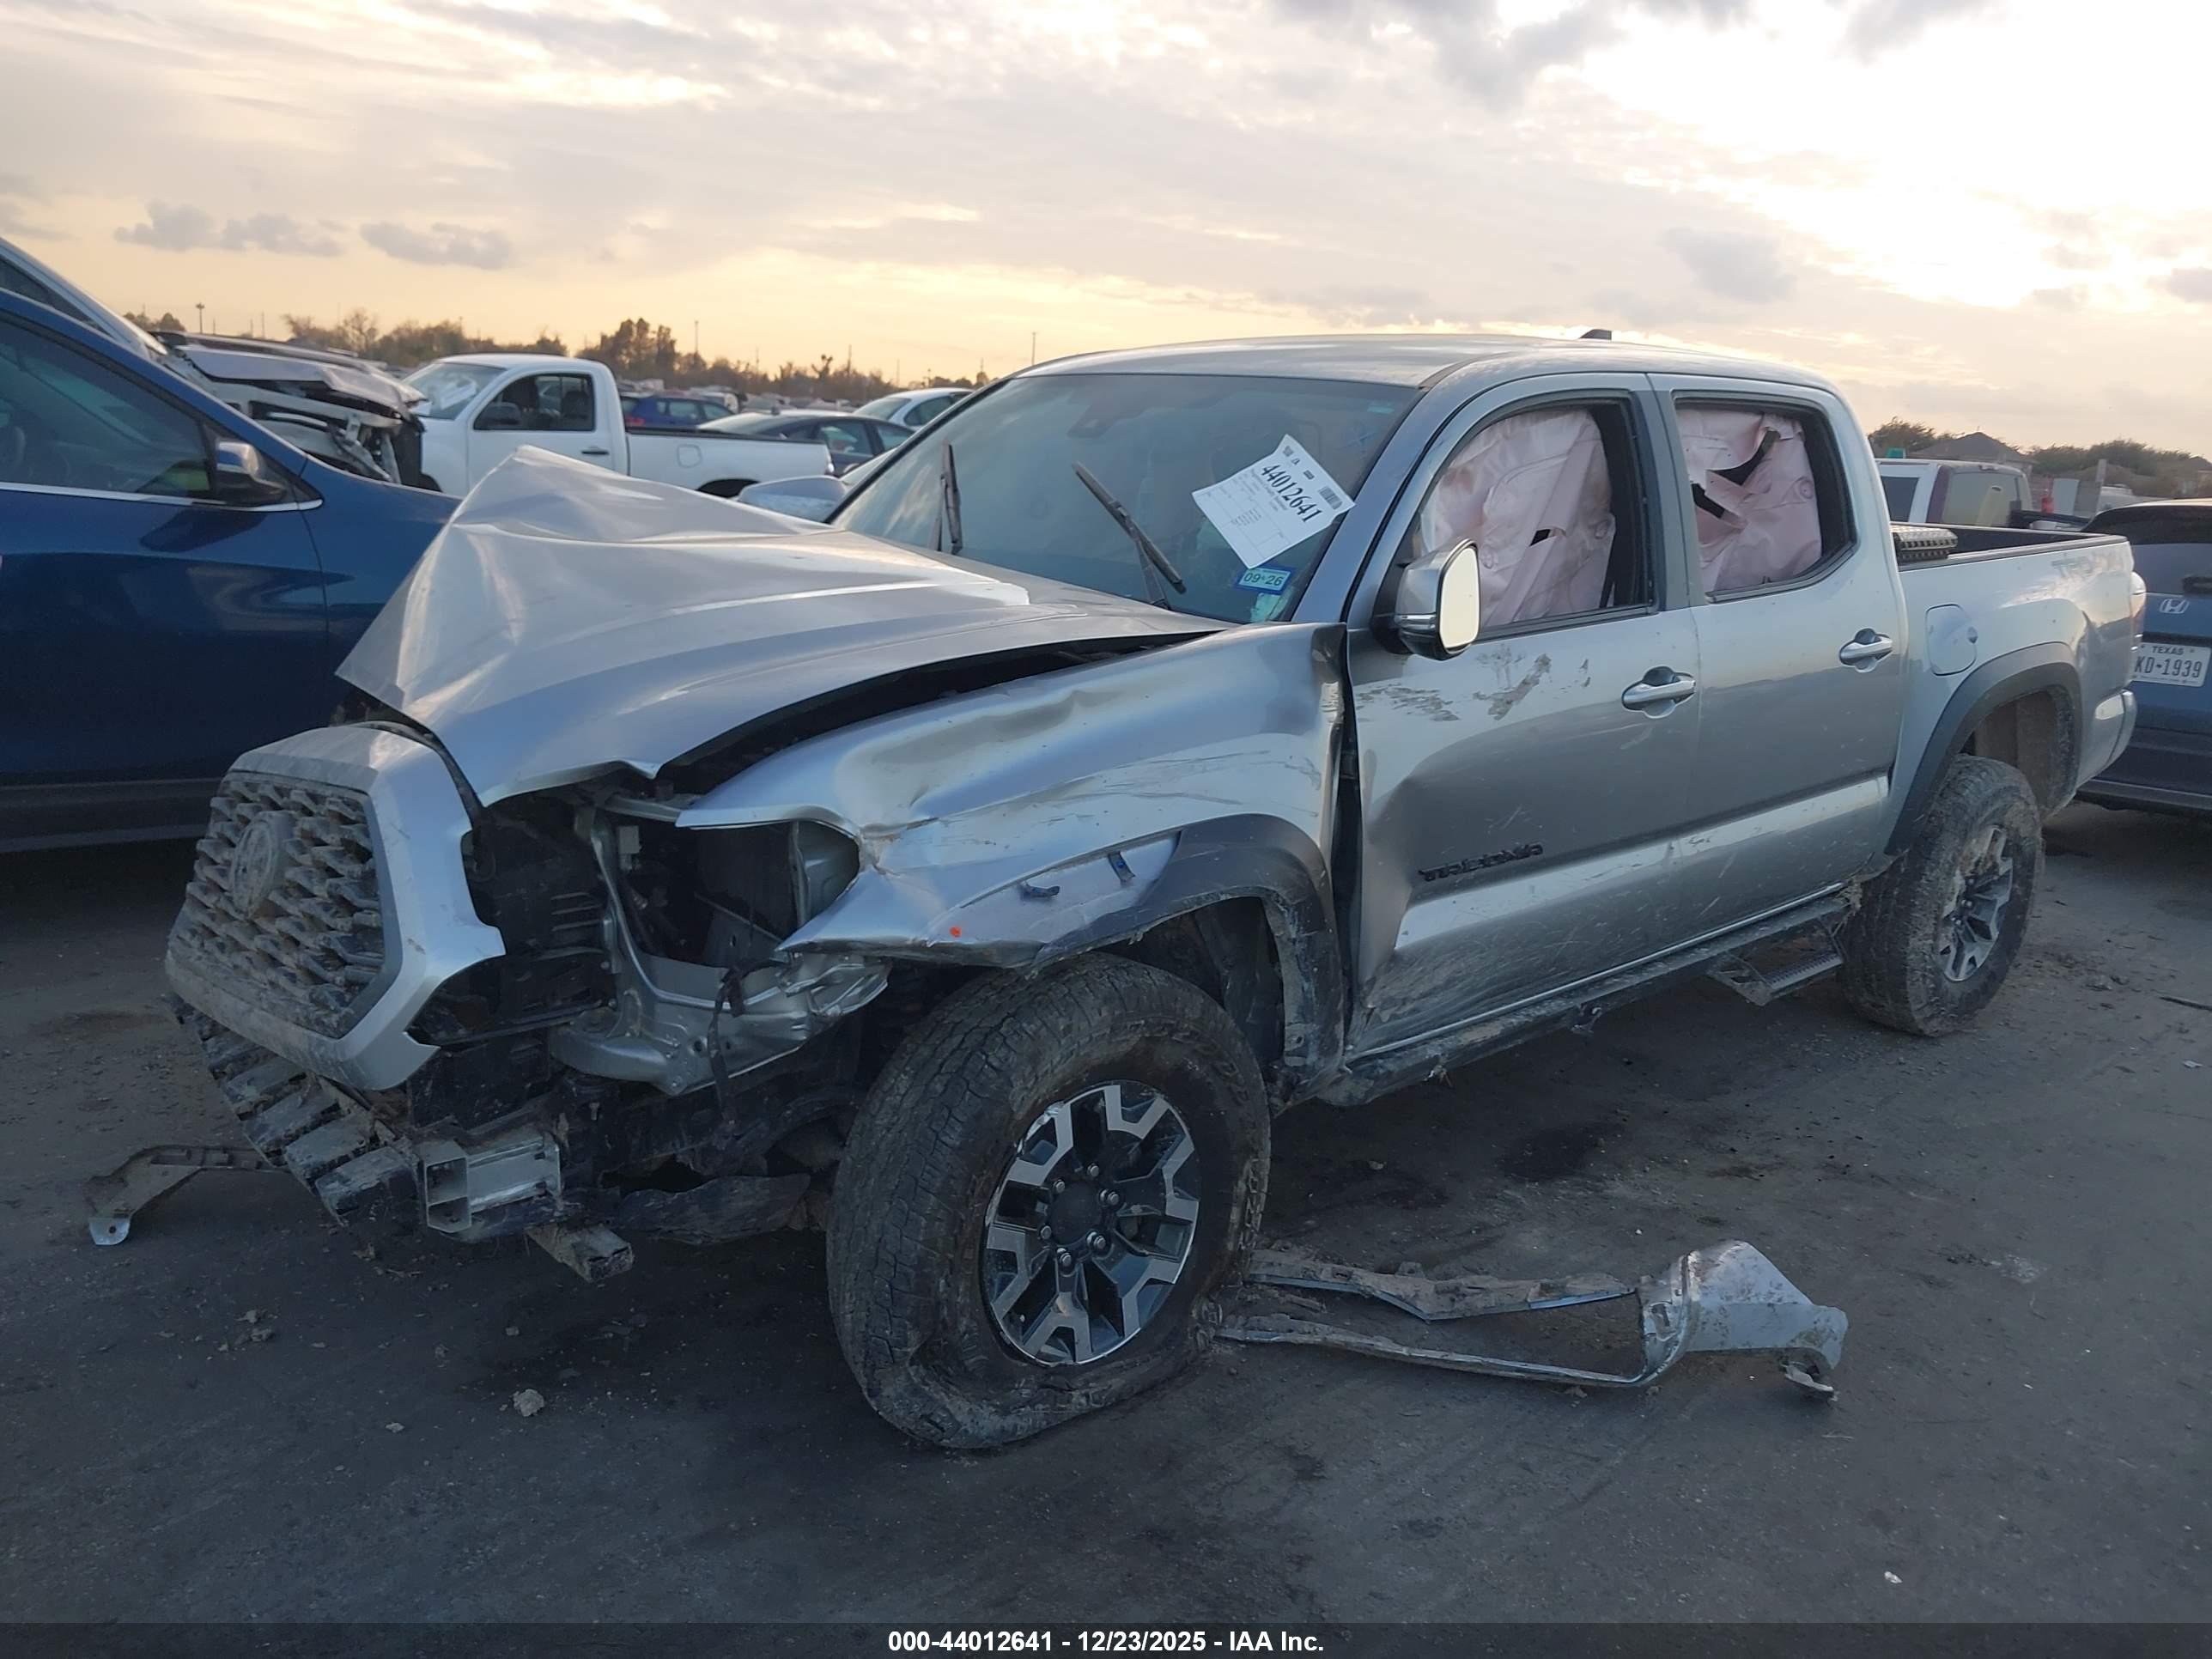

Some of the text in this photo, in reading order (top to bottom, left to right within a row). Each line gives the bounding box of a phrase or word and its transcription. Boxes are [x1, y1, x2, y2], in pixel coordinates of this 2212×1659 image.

[1261, 465, 1322, 522] 44012641
[1243, 572, 1284, 586] 09 26
[2151, 646, 2185, 655] TEXAS
